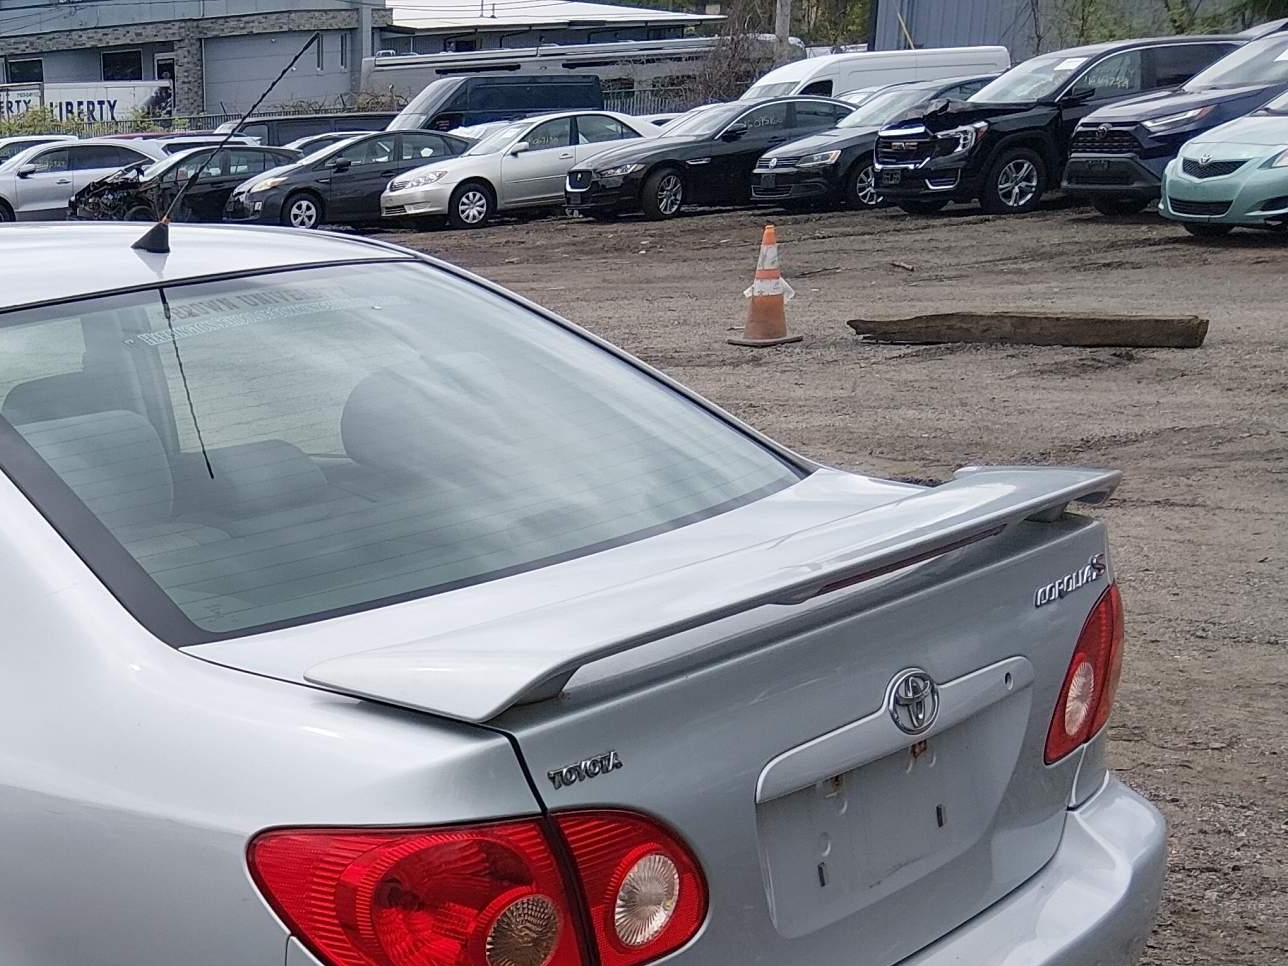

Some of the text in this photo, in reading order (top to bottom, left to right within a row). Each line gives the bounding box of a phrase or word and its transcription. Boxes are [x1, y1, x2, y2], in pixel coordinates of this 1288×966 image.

[49, 99, 118, 123] LIBERTY
[1032, 565, 1097, 608] COROLLA
[546, 749, 624, 791] TOYOTA
